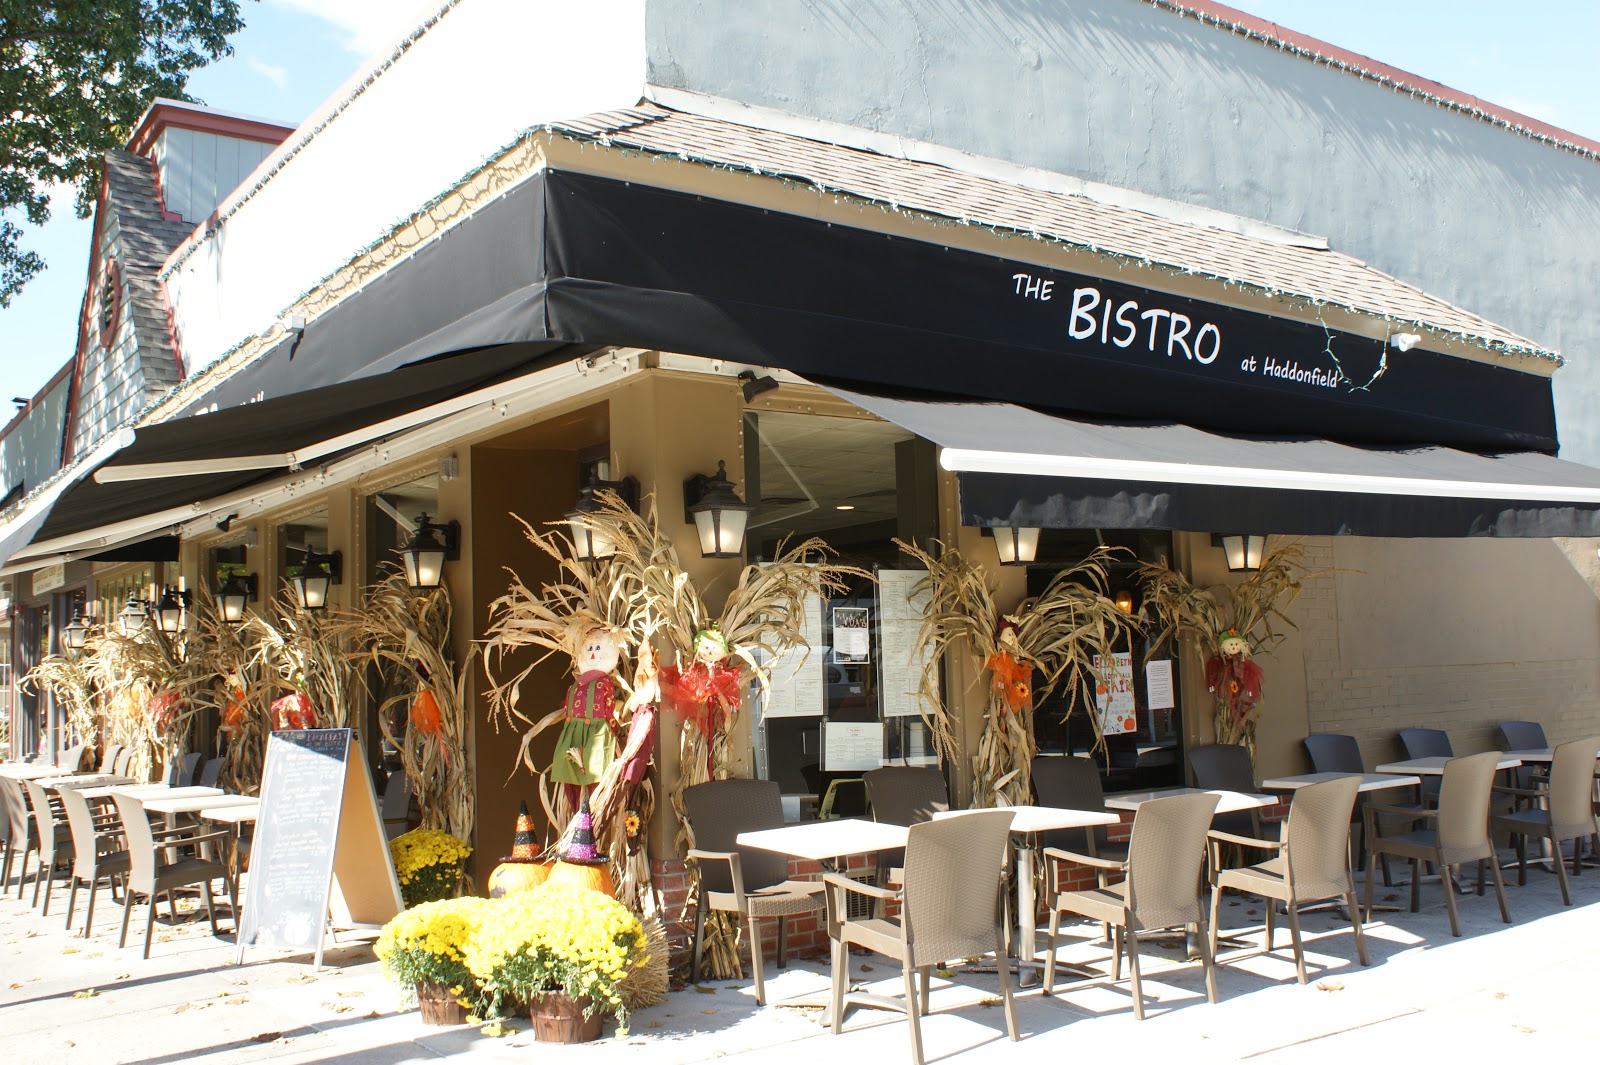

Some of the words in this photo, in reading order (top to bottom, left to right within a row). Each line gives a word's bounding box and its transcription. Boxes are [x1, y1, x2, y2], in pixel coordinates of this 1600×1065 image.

[1012, 273, 1055, 301] THE
[1068, 288, 1221, 365] BISTRO
[1241, 356, 1257, 373] at
[1263, 356, 1338, 388] Haddonfield
